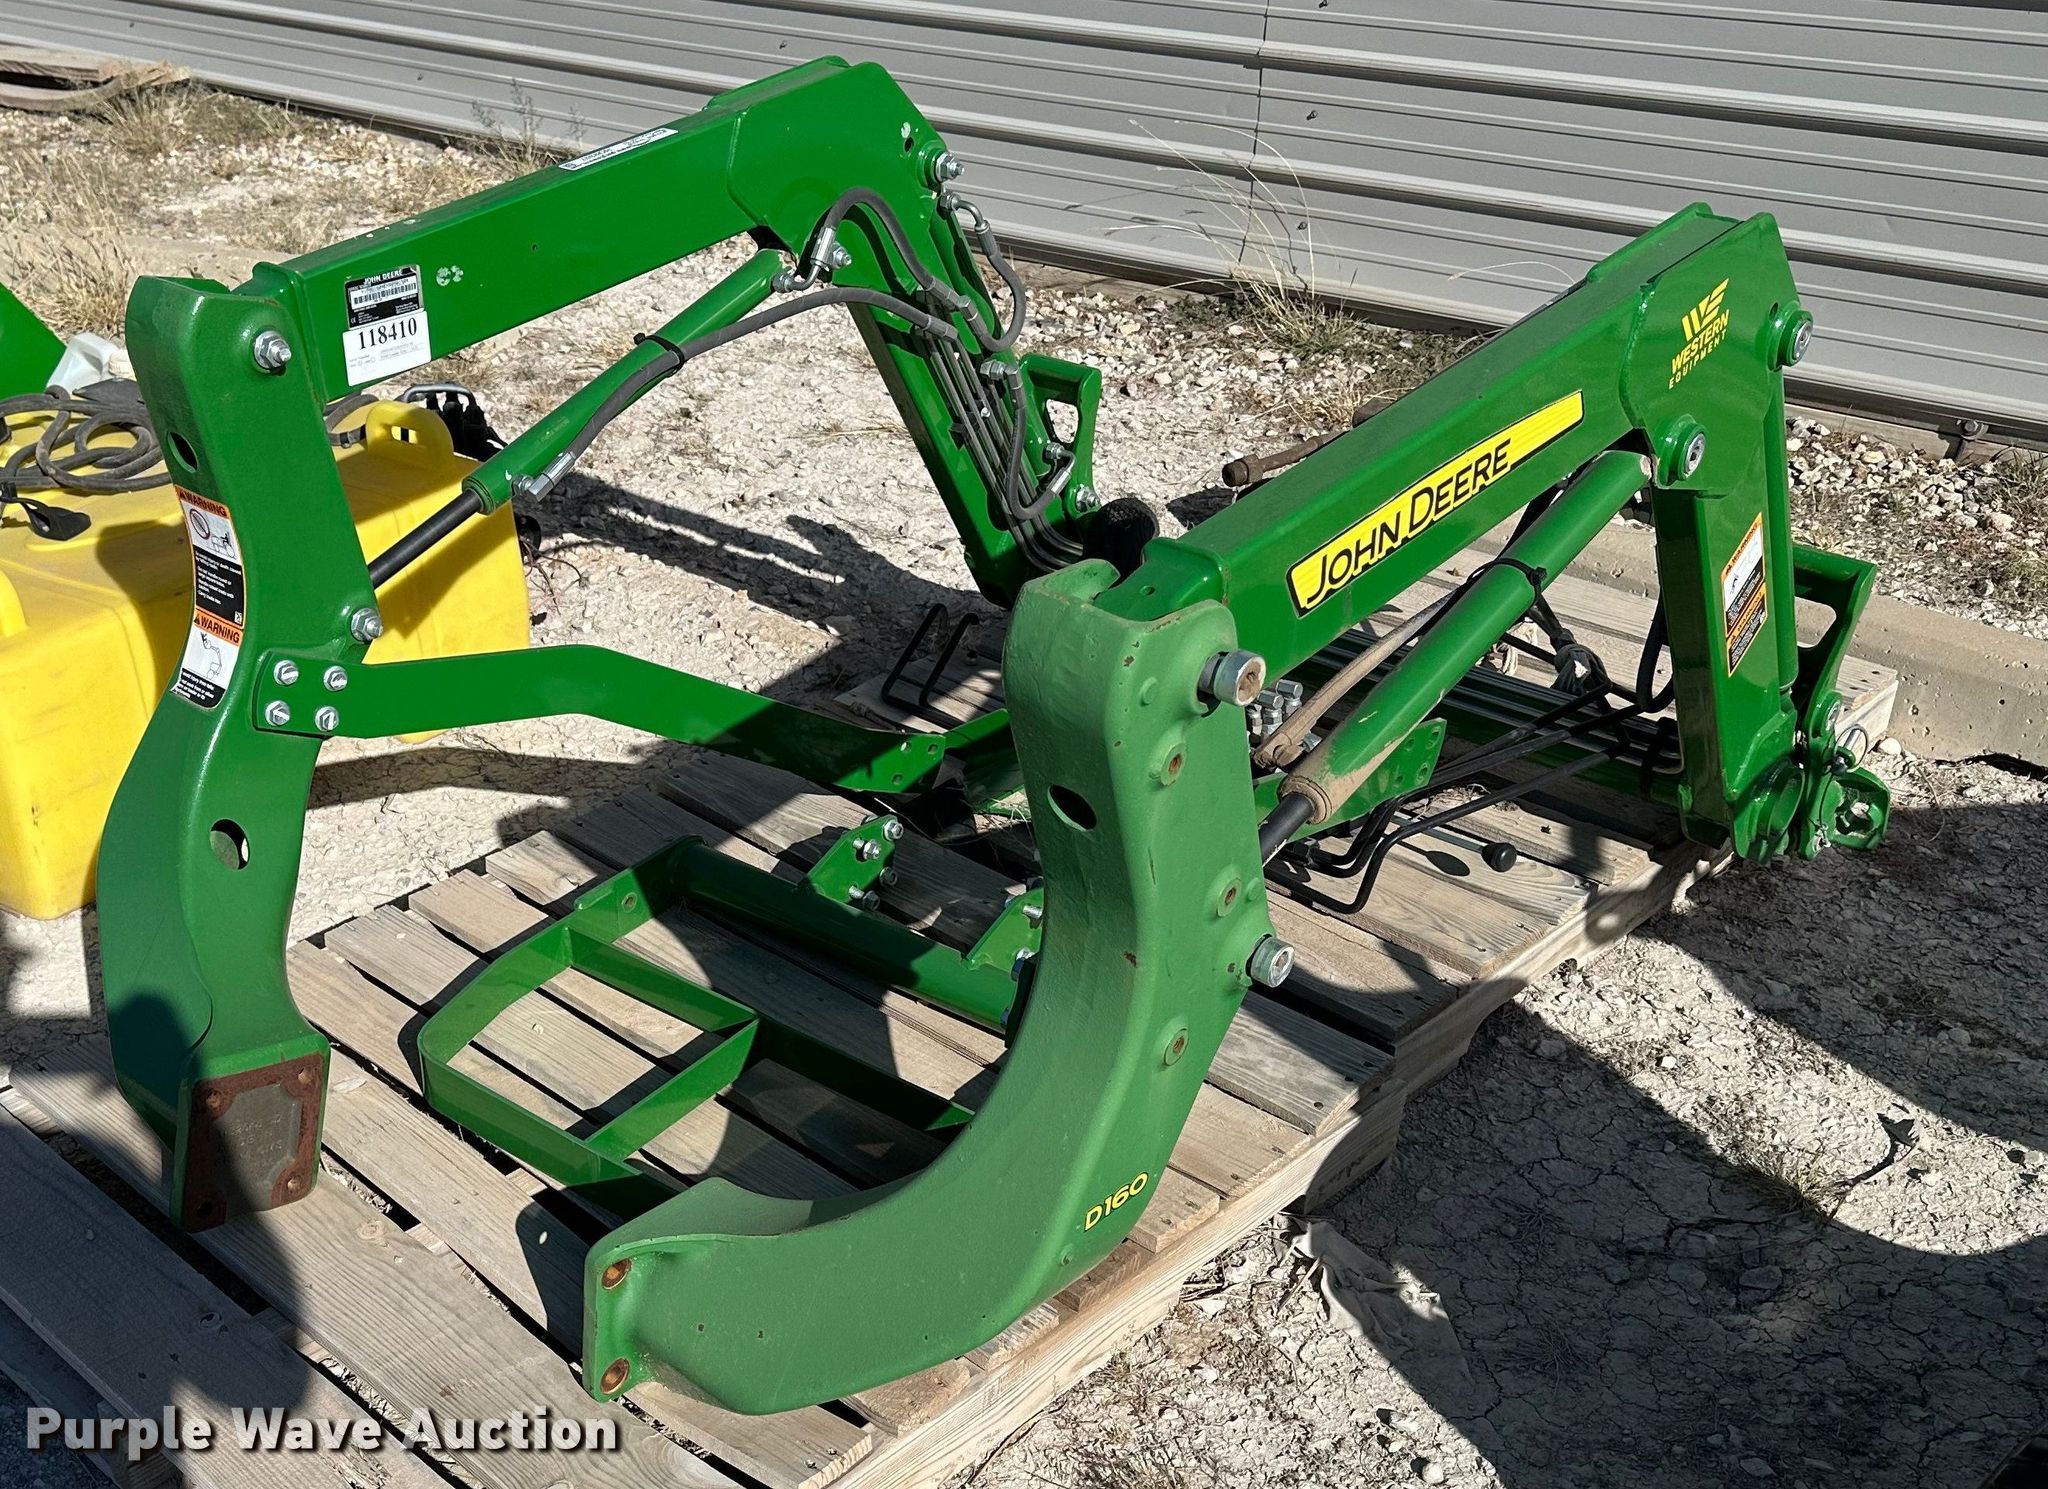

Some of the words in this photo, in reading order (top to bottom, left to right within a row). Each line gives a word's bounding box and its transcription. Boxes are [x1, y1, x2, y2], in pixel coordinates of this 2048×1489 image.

[359, 317, 418, 350] 118410
[1668, 329, 1727, 390] EQUIPMENT
[1672, 309, 1729, 374] WESTERN
[184, 491, 228, 517] WARNING
[1306, 511, 1402, 605] JOHN
[1408, 437, 1512, 534] DEERE
[200, 615, 240, 644] WARNING
[1084, 1171, 1149, 1232] D160
